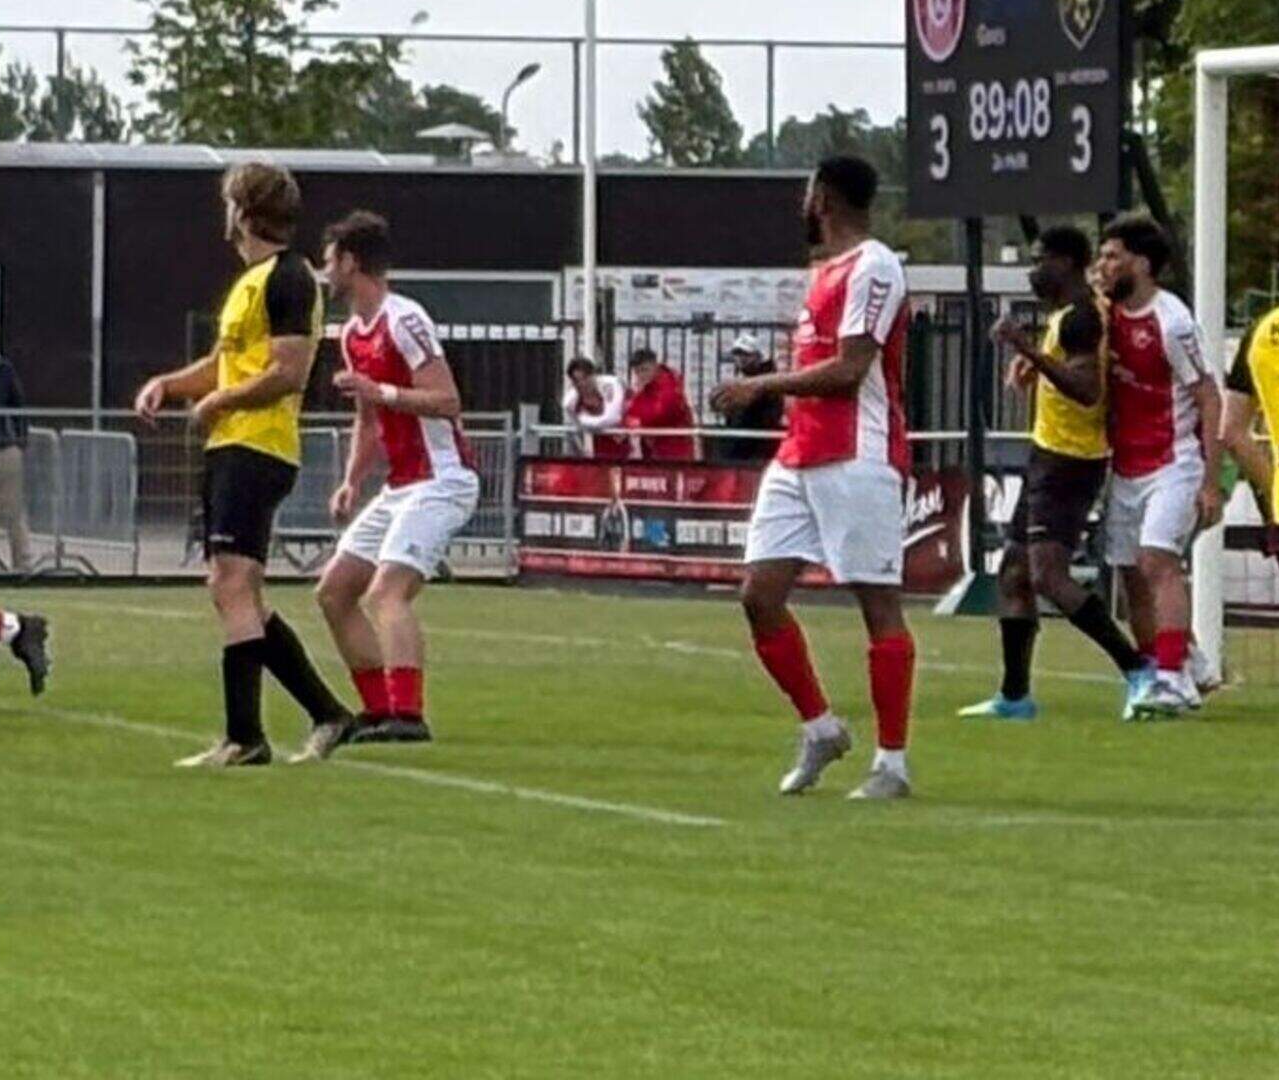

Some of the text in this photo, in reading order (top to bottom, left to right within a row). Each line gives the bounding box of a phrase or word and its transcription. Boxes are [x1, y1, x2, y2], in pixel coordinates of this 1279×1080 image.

[970, 77, 1051, 141] 89:08
[1071, 104, 1092, 173] 3
[930, 114, 951, 180] 3
